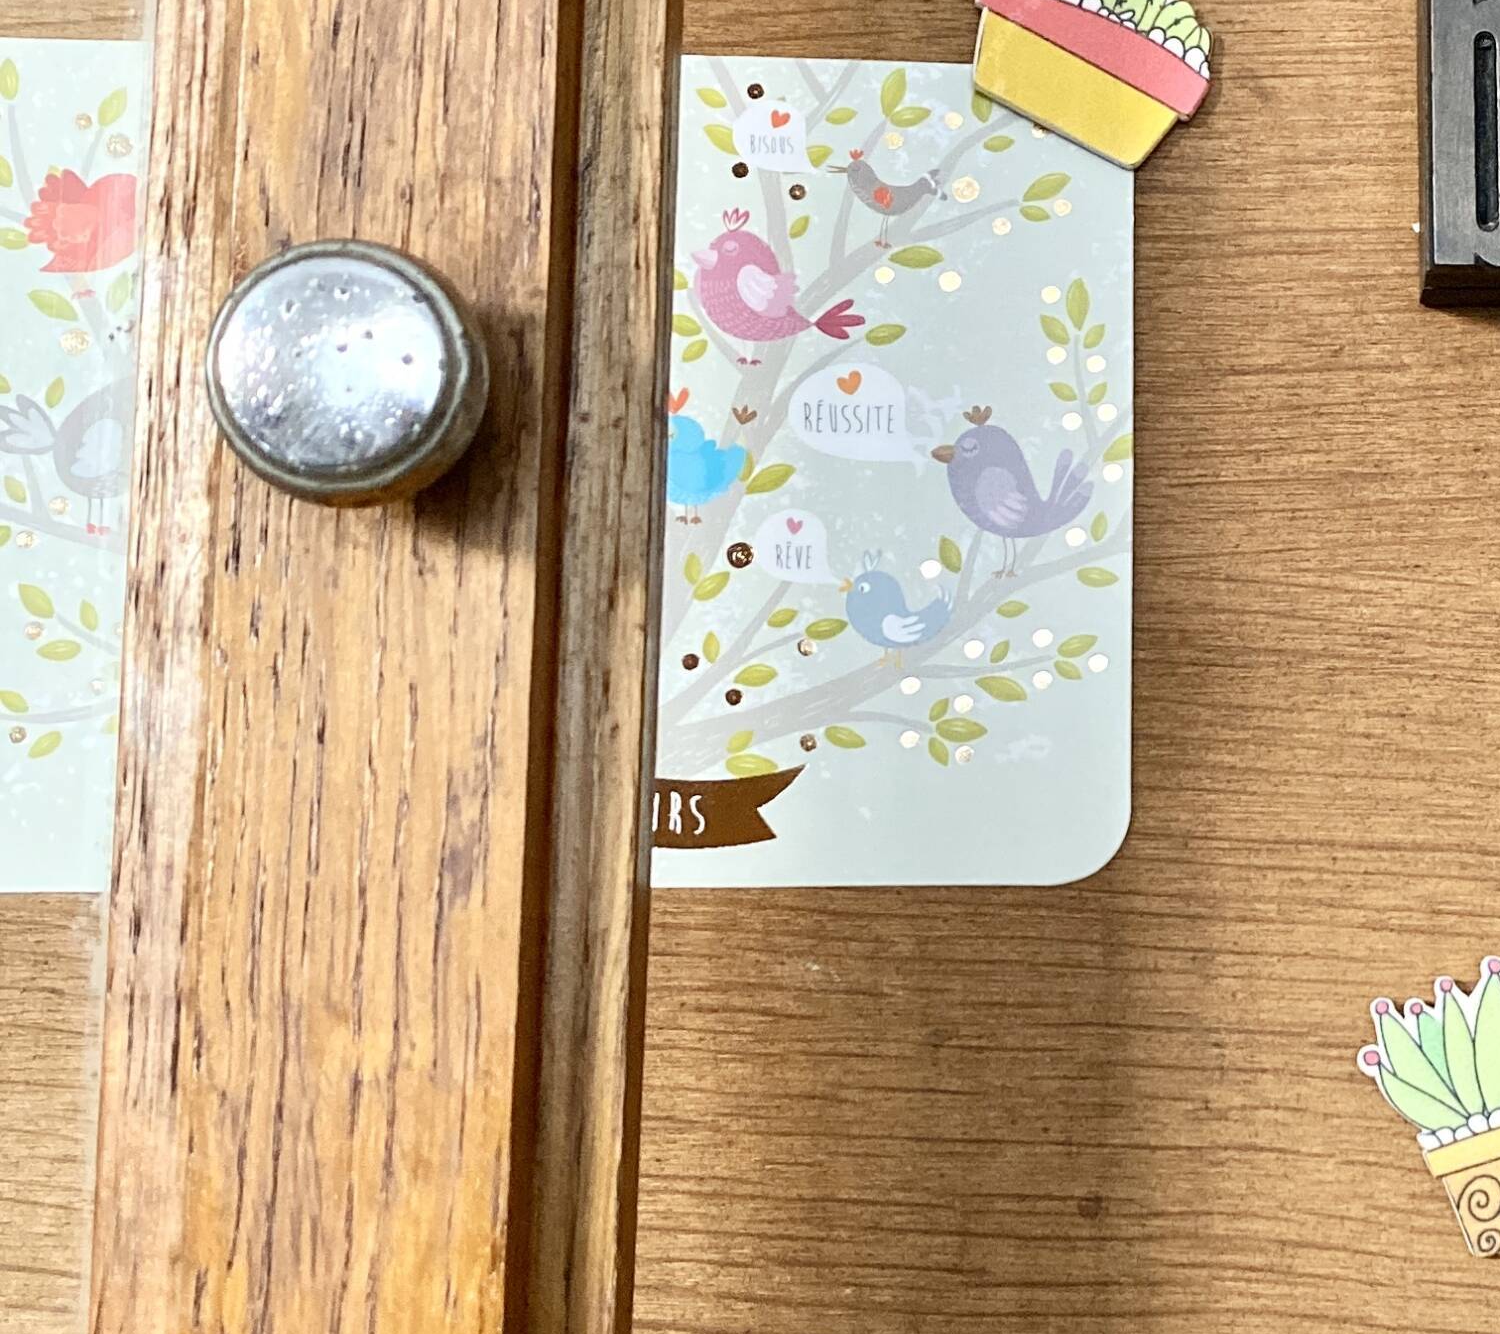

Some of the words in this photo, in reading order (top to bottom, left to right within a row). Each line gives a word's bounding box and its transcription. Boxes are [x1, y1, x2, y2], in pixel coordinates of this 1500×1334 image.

[750, 133, 795, 155] BISOUS
[803, 399, 895, 434] RÉUSSITE
[775, 541, 813, 570] RÊVE
